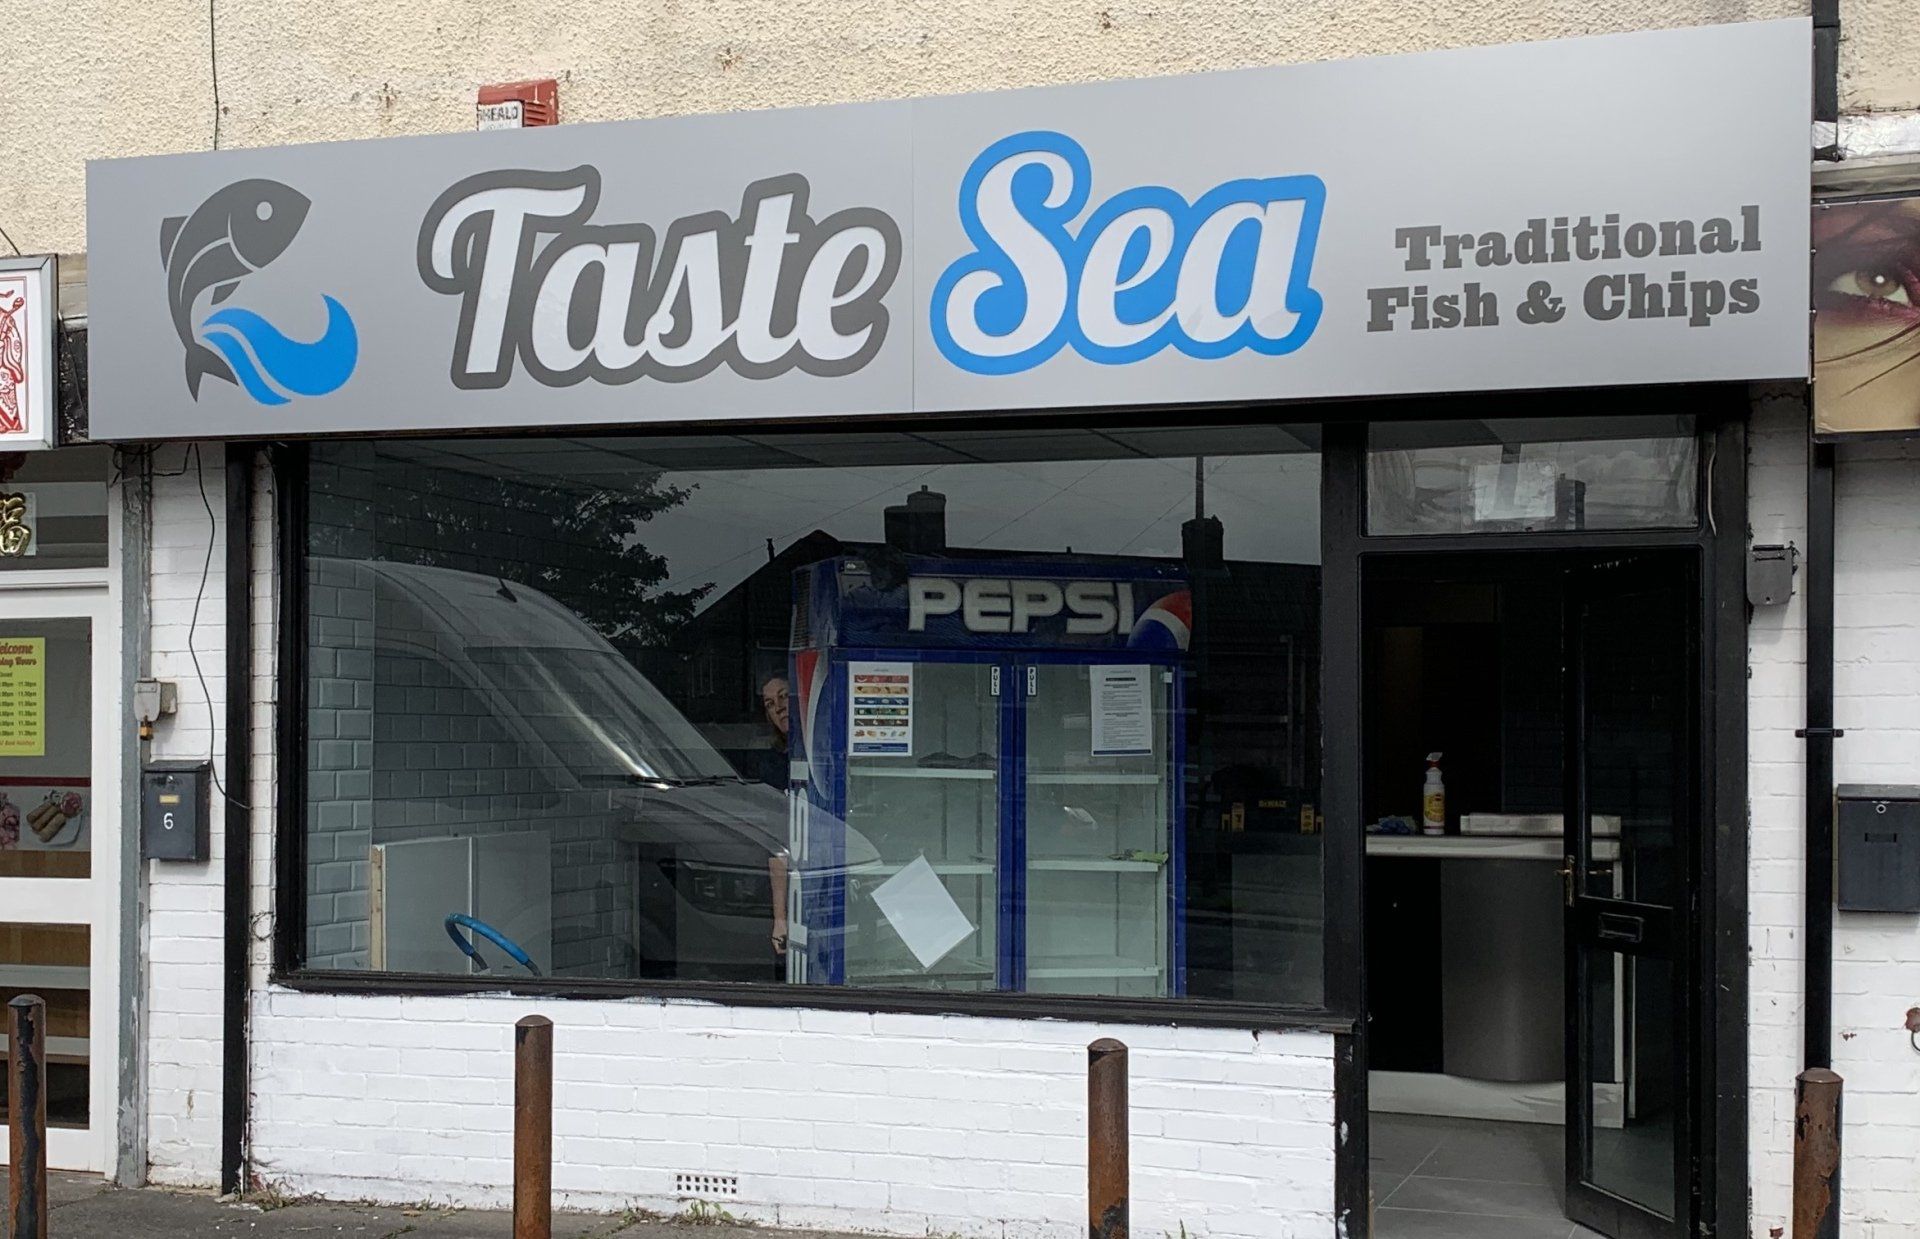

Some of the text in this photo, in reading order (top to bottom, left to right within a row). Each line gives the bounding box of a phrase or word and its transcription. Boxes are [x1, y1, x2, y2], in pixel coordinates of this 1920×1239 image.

[417, 131, 1326, 389] Taste Sea
[1395, 205, 1761, 271] Traditional
[1367, 271, 1761, 332] Fish & Chips
[908, 577, 1135, 635] PEPSI
[0, 643, 33, 654] elcome
[163, 812, 174, 830] 6
